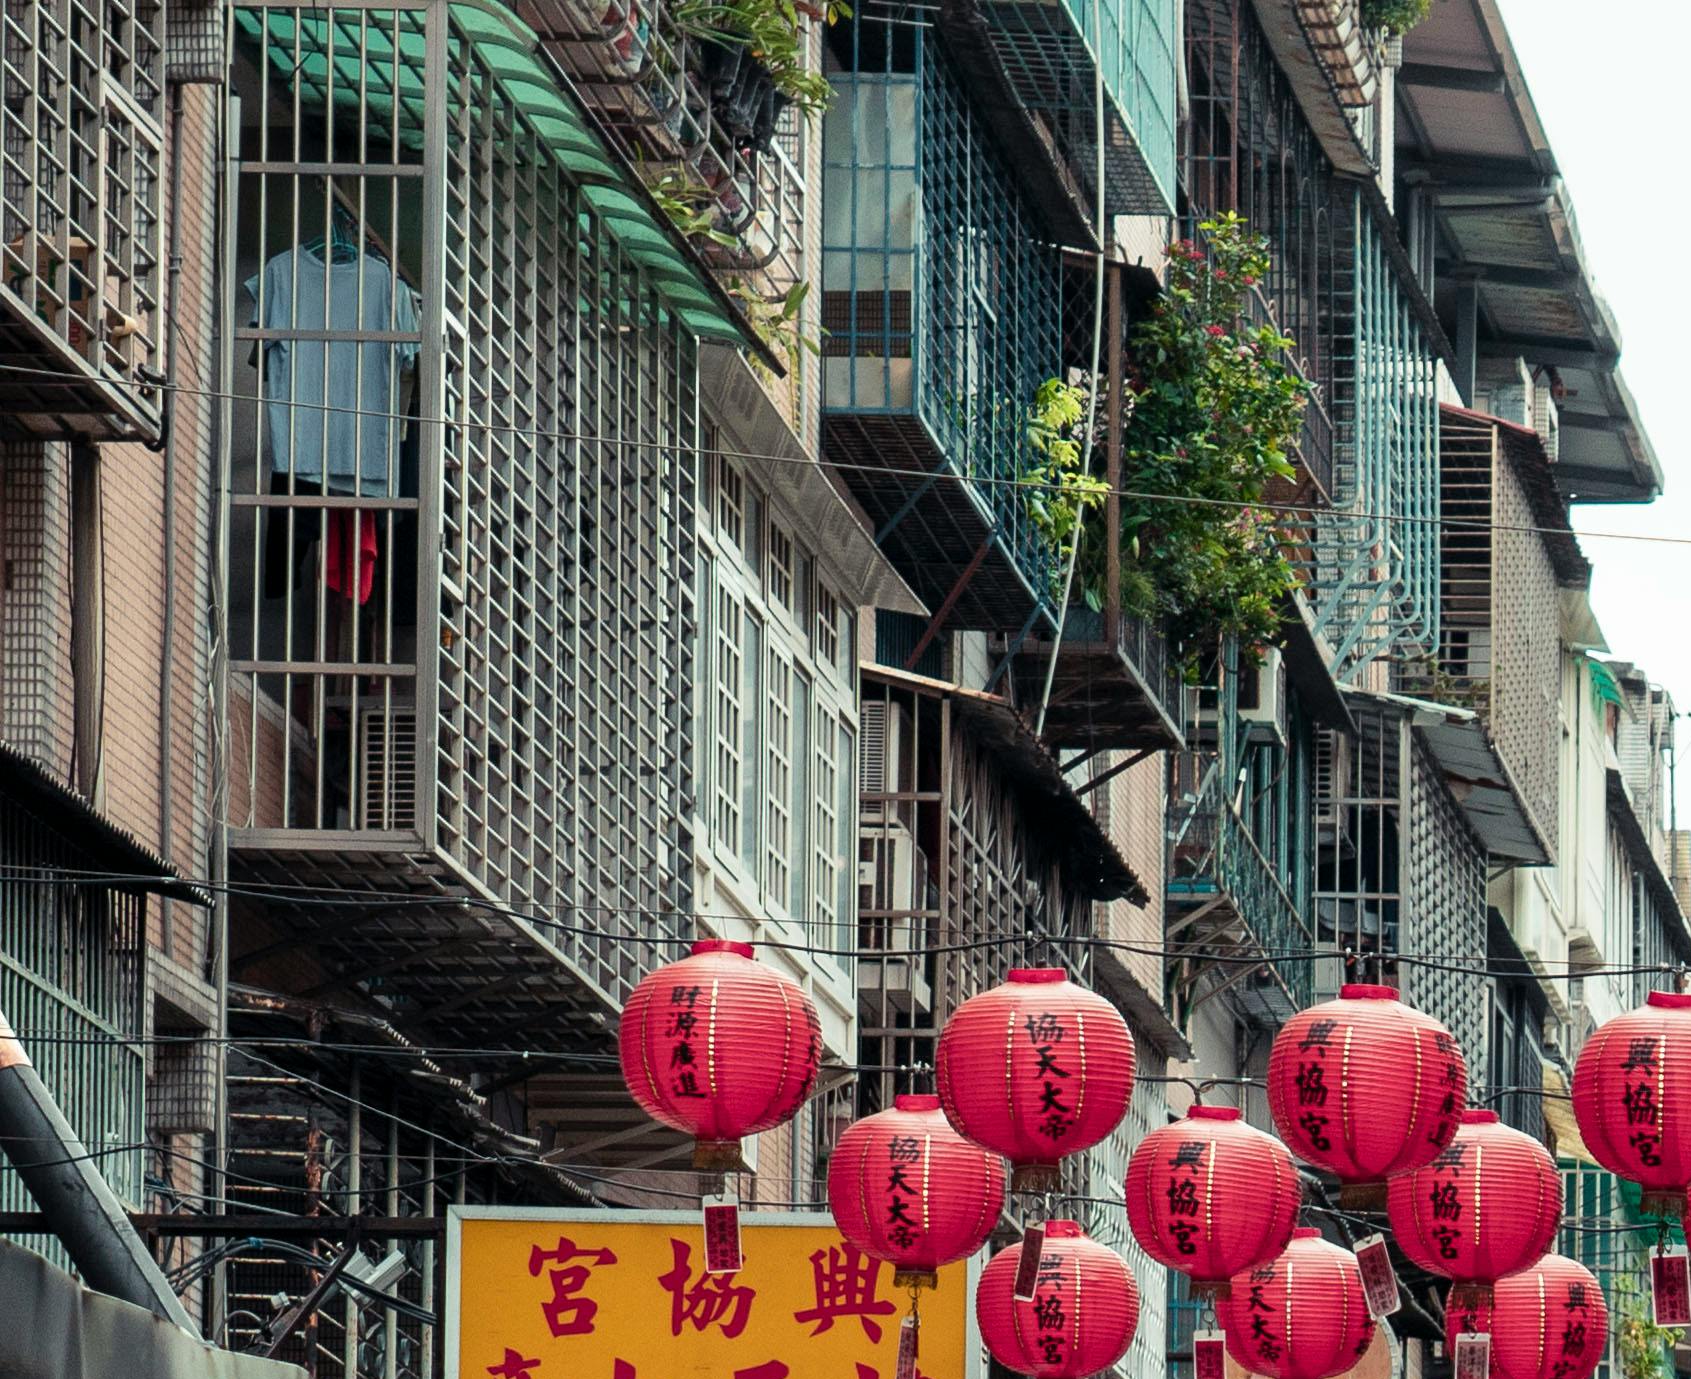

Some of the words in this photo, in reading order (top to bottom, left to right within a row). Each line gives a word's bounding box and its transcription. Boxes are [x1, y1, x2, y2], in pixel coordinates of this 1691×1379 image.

[1023, 1012, 1076, 1141] 協天大帝
[1295, 1018, 1337, 1154] 興協宮
[1620, 1037, 1661, 1168] 興協宮
[884, 1135, 919, 1248] 協天大帝
[1165, 1140, 1204, 1257] 興協宮
[1429, 1142, 1465, 1261] 興協宮
[1032, 1254, 1065, 1365] 興協宮
